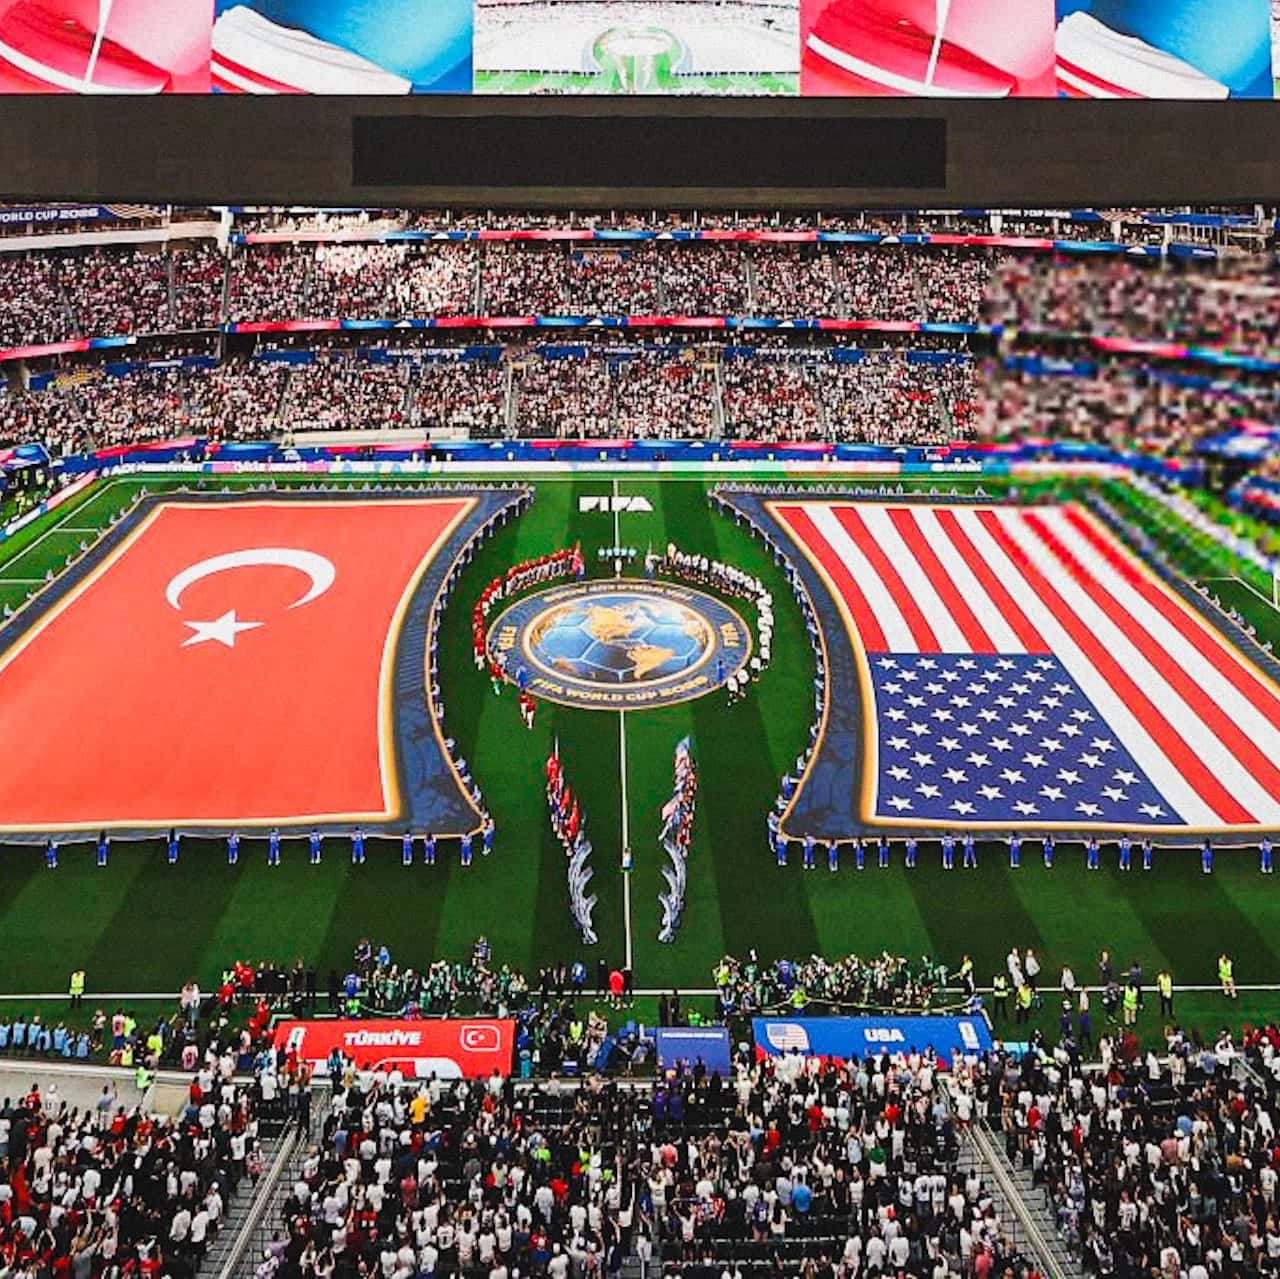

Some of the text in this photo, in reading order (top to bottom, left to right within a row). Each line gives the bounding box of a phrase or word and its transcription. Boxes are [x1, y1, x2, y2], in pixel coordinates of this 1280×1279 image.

[35, 209, 58, 221] CUP
[579, 495, 654, 512] FIFA
[531, 677, 564, 695] FIFA
[566, 688, 624, 702] WORLD
[625, 690, 658, 701] CUP
[343, 1028, 423, 1046] TÜRKİYE
[863, 1027, 906, 1043] USA
